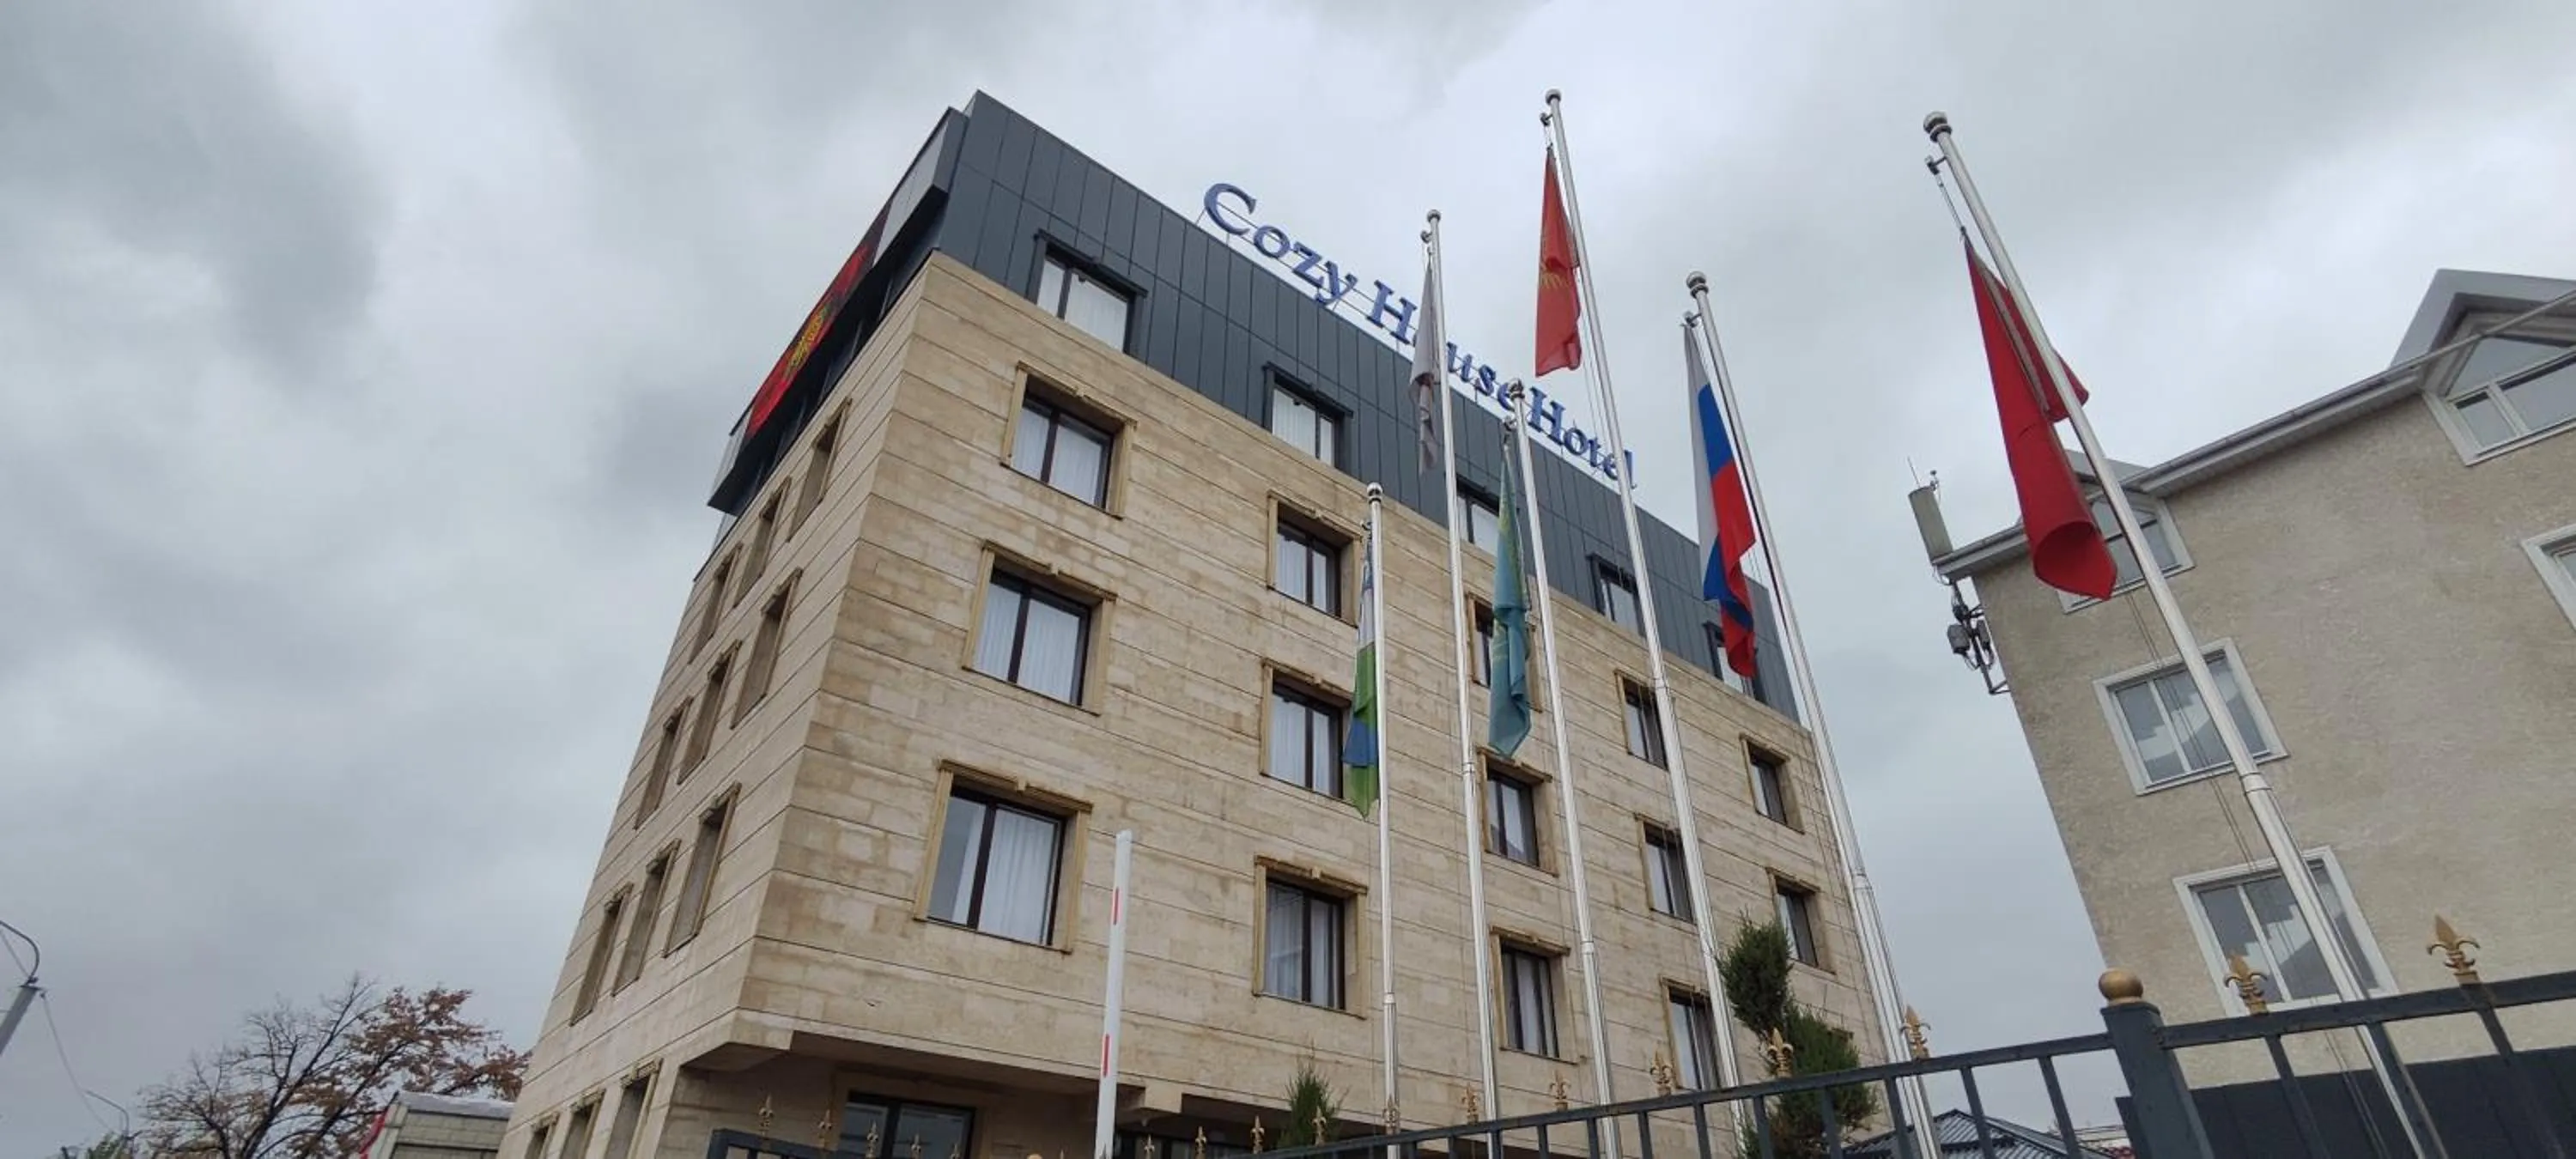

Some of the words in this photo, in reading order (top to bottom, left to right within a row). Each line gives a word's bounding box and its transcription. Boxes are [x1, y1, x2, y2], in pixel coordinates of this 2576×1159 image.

[1204, 183, 1358, 307] Cozy
[1366, 280, 1519, 412] Huse
[1528, 386, 1637, 489] Hotel
